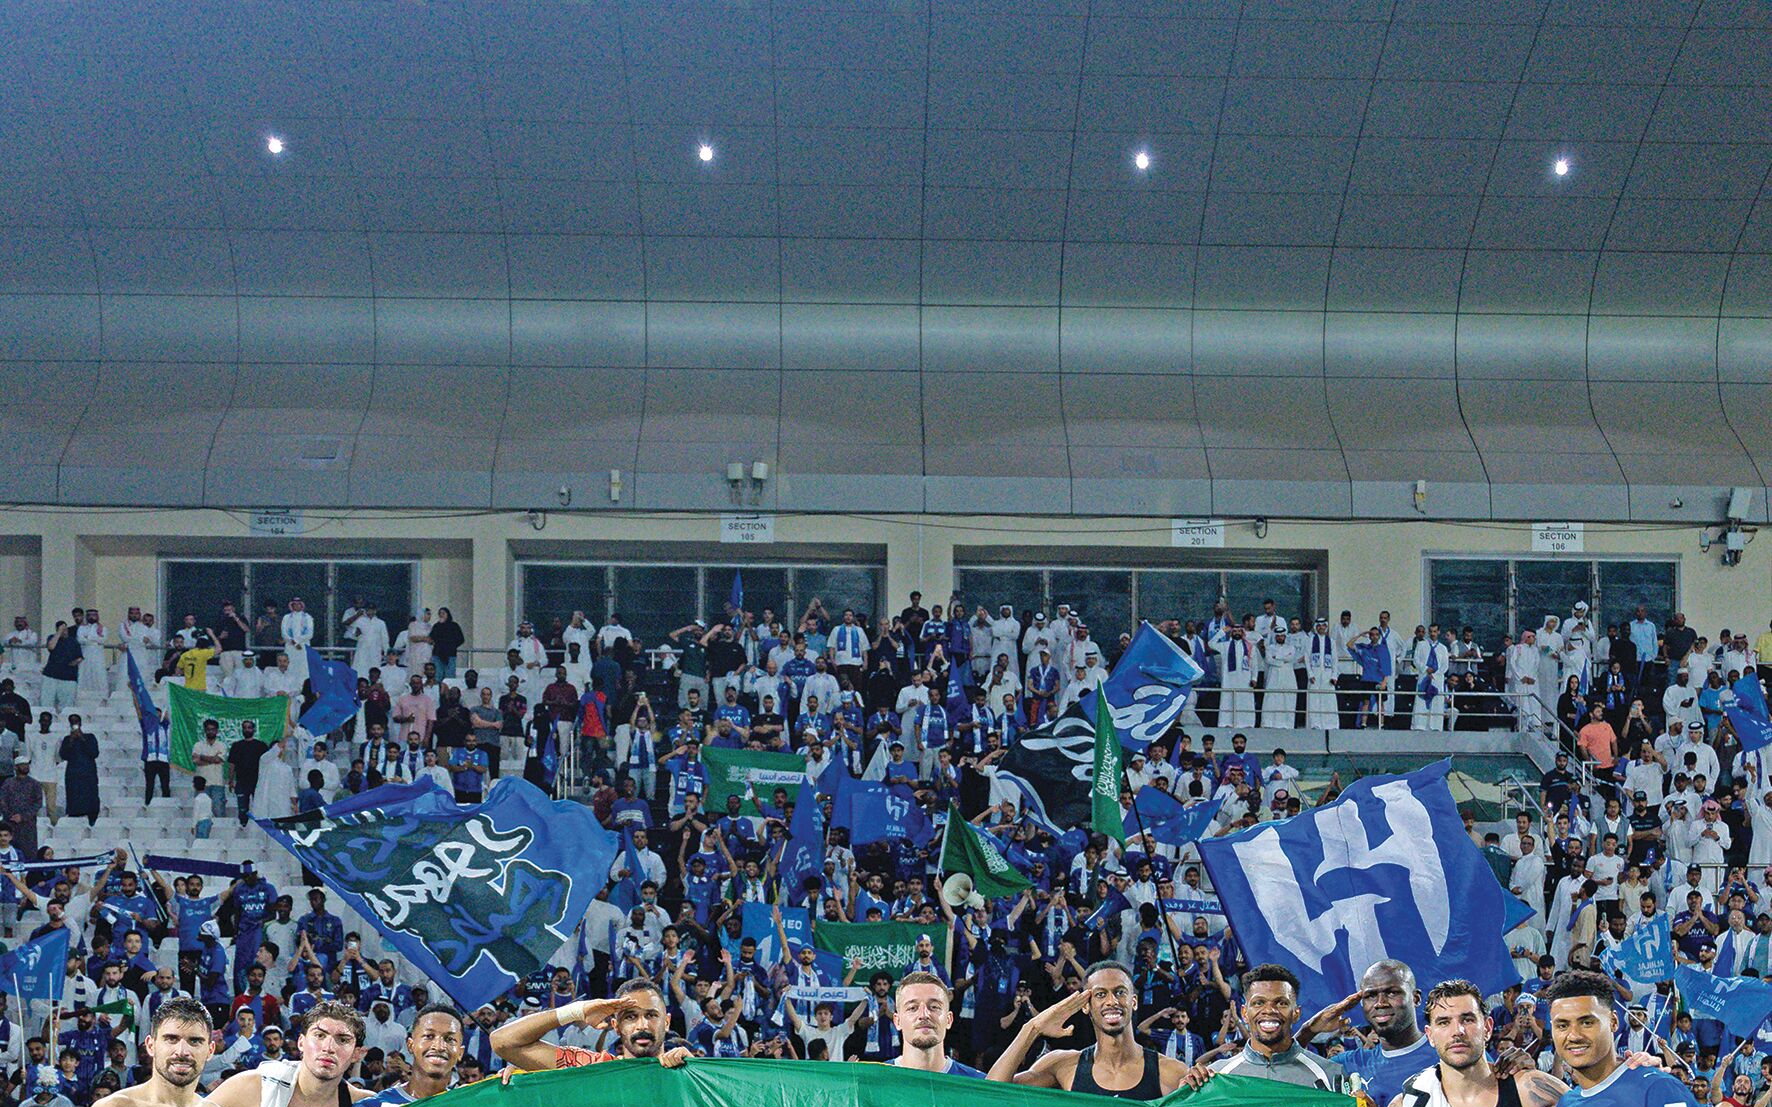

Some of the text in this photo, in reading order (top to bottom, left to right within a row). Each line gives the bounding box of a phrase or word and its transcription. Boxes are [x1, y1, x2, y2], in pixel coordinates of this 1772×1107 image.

[257, 516, 297, 525] SECTION
[727, 522, 767, 530] SECTION
[1179, 527, 1217, 535] SECTION
[740, 533, 756, 541] 105
[1539, 532, 1577, 540] SECTION
[1551, 543, 1566, 551] 106
